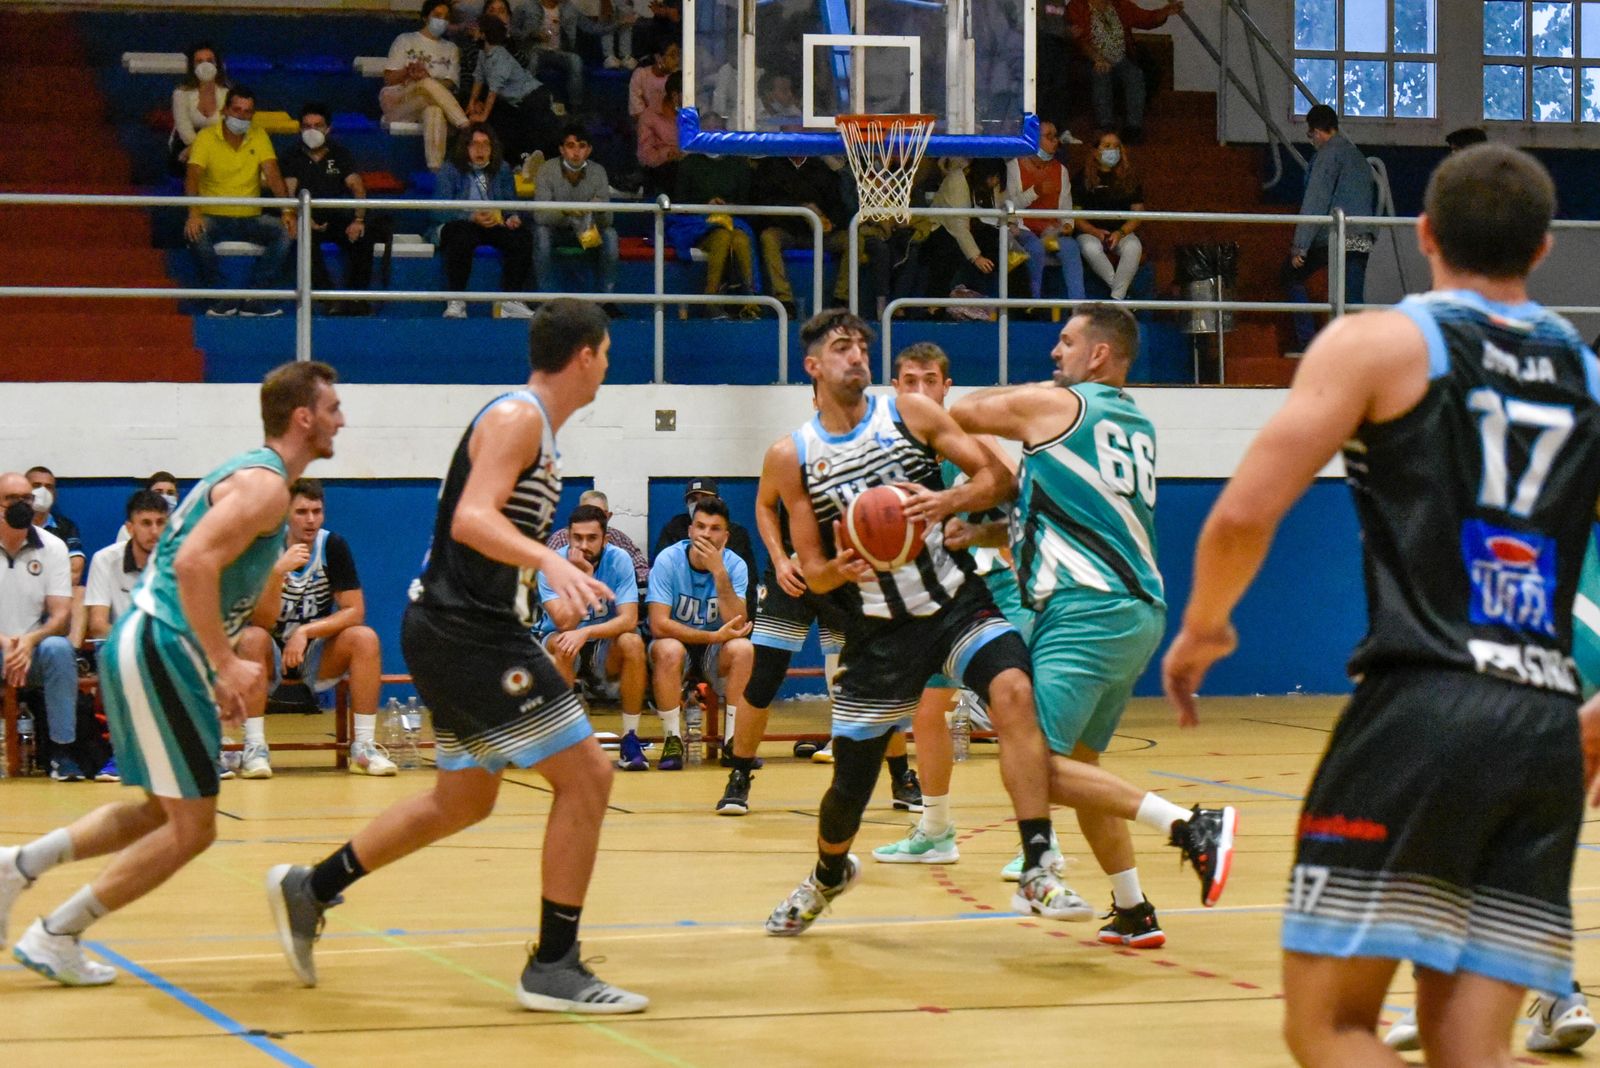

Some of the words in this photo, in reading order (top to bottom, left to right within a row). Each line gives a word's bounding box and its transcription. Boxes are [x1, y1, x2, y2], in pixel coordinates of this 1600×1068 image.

[1093, 418, 1157, 510] 66
[1467, 388, 1575, 517] 17
[675, 593, 720, 625] ULB
[1293, 865, 1330, 914] 17
